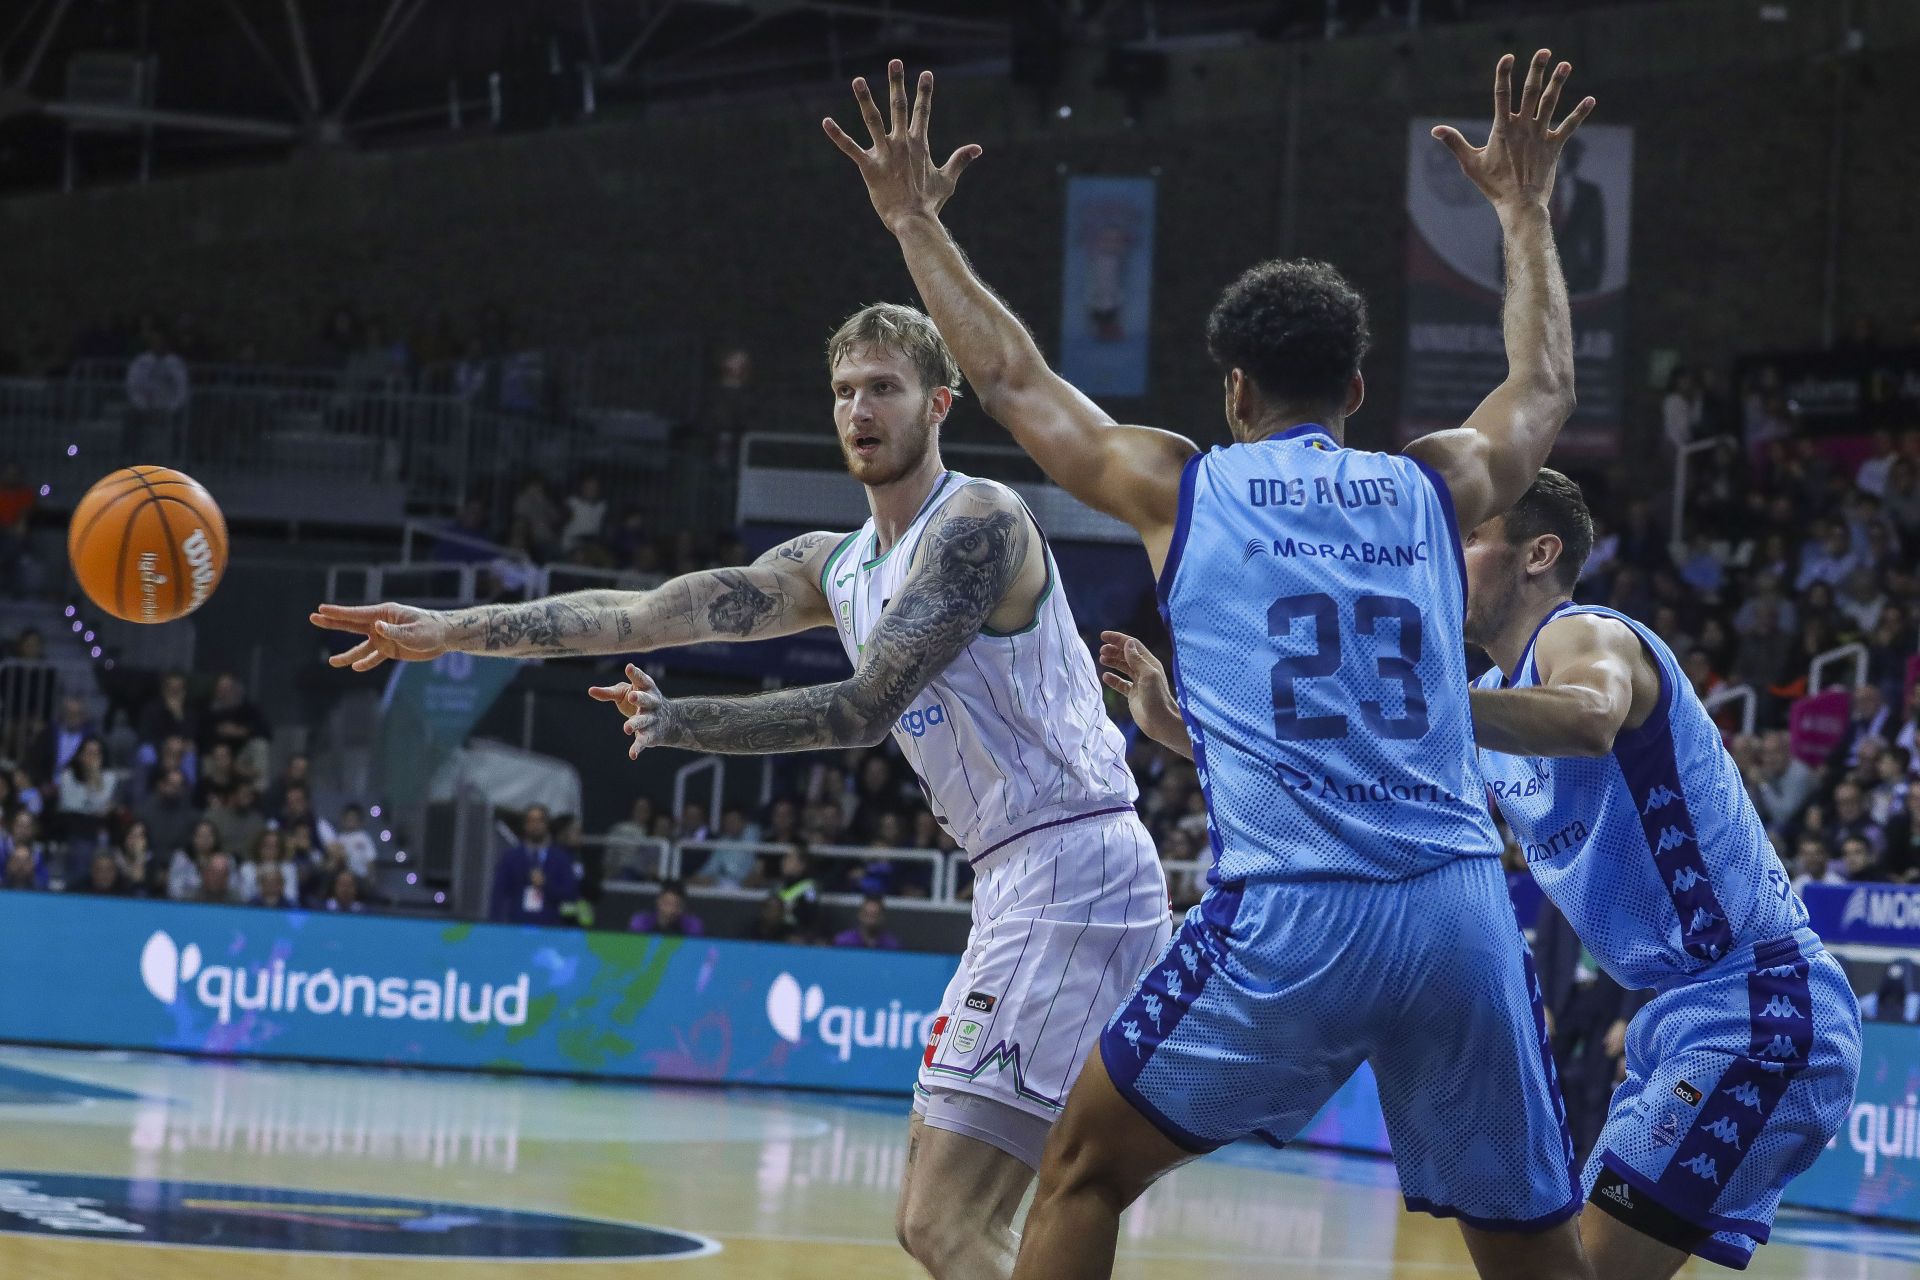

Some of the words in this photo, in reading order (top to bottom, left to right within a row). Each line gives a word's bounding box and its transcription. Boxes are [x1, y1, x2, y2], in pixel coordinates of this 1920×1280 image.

[1248, 477, 1306, 507] DOS
[1266, 592, 1430, 741] 23
[892, 703, 945, 738] aga
[196, 957, 530, 1026] quirónsalud
[967, 997, 987, 1010] acb
[1675, 1086, 1694, 1103] acb
[1849, 1094, 1920, 1177] qui
[1601, 1187, 1635, 1210] adidas
